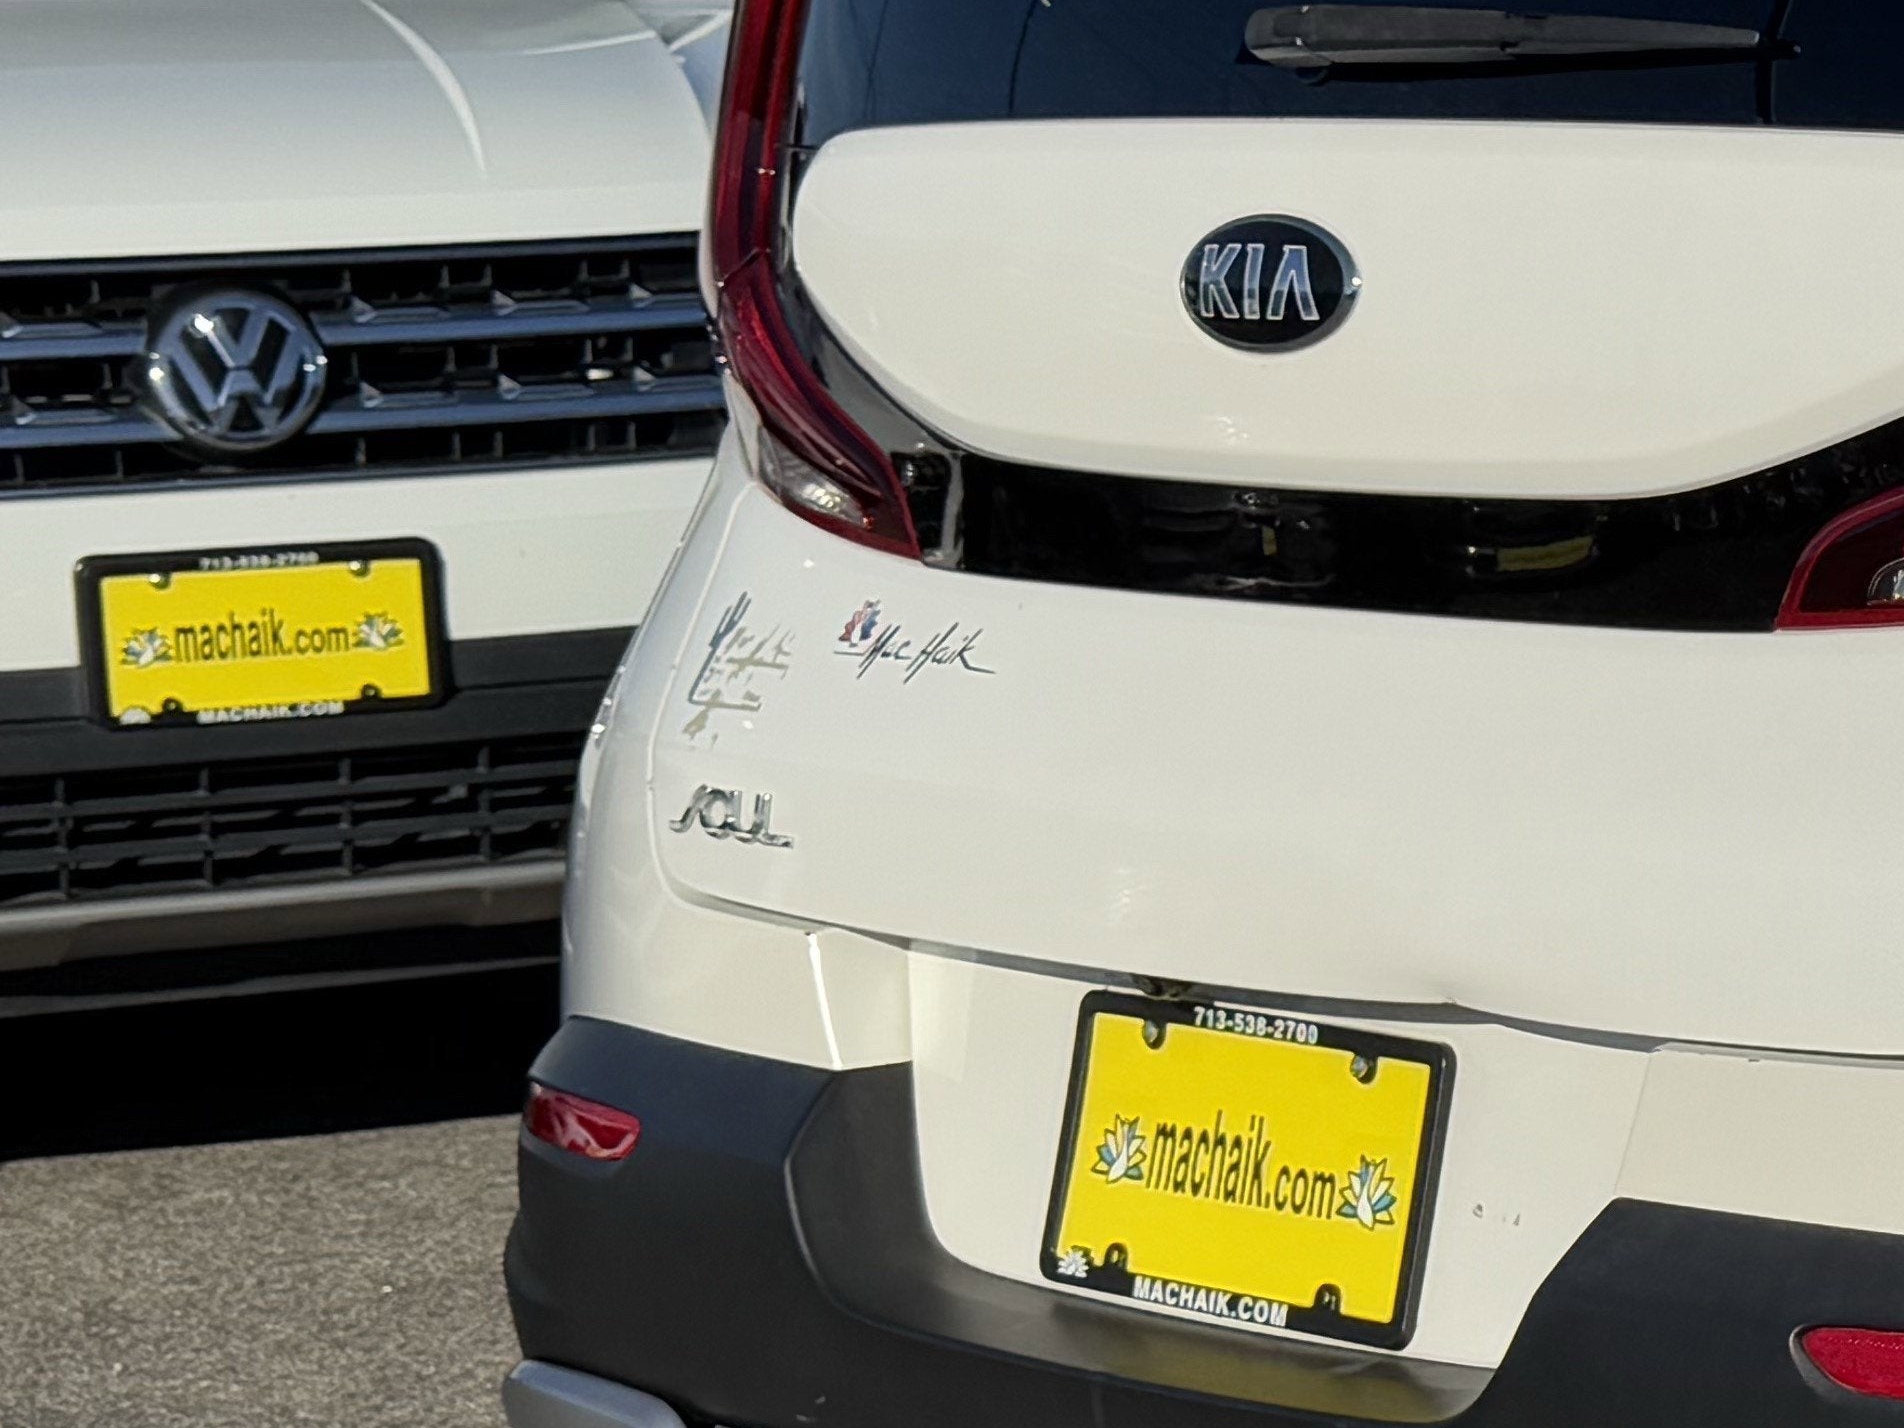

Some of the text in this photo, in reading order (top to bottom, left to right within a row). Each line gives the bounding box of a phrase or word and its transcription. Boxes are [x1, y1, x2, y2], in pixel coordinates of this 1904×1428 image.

[1200, 242, 1320, 321] KIA
[174, 608, 351, 663] machaik.com
[1145, 1108, 1337, 1221] machaik.com
[1131, 1275, 1289, 1327] MACHAIK.COM
